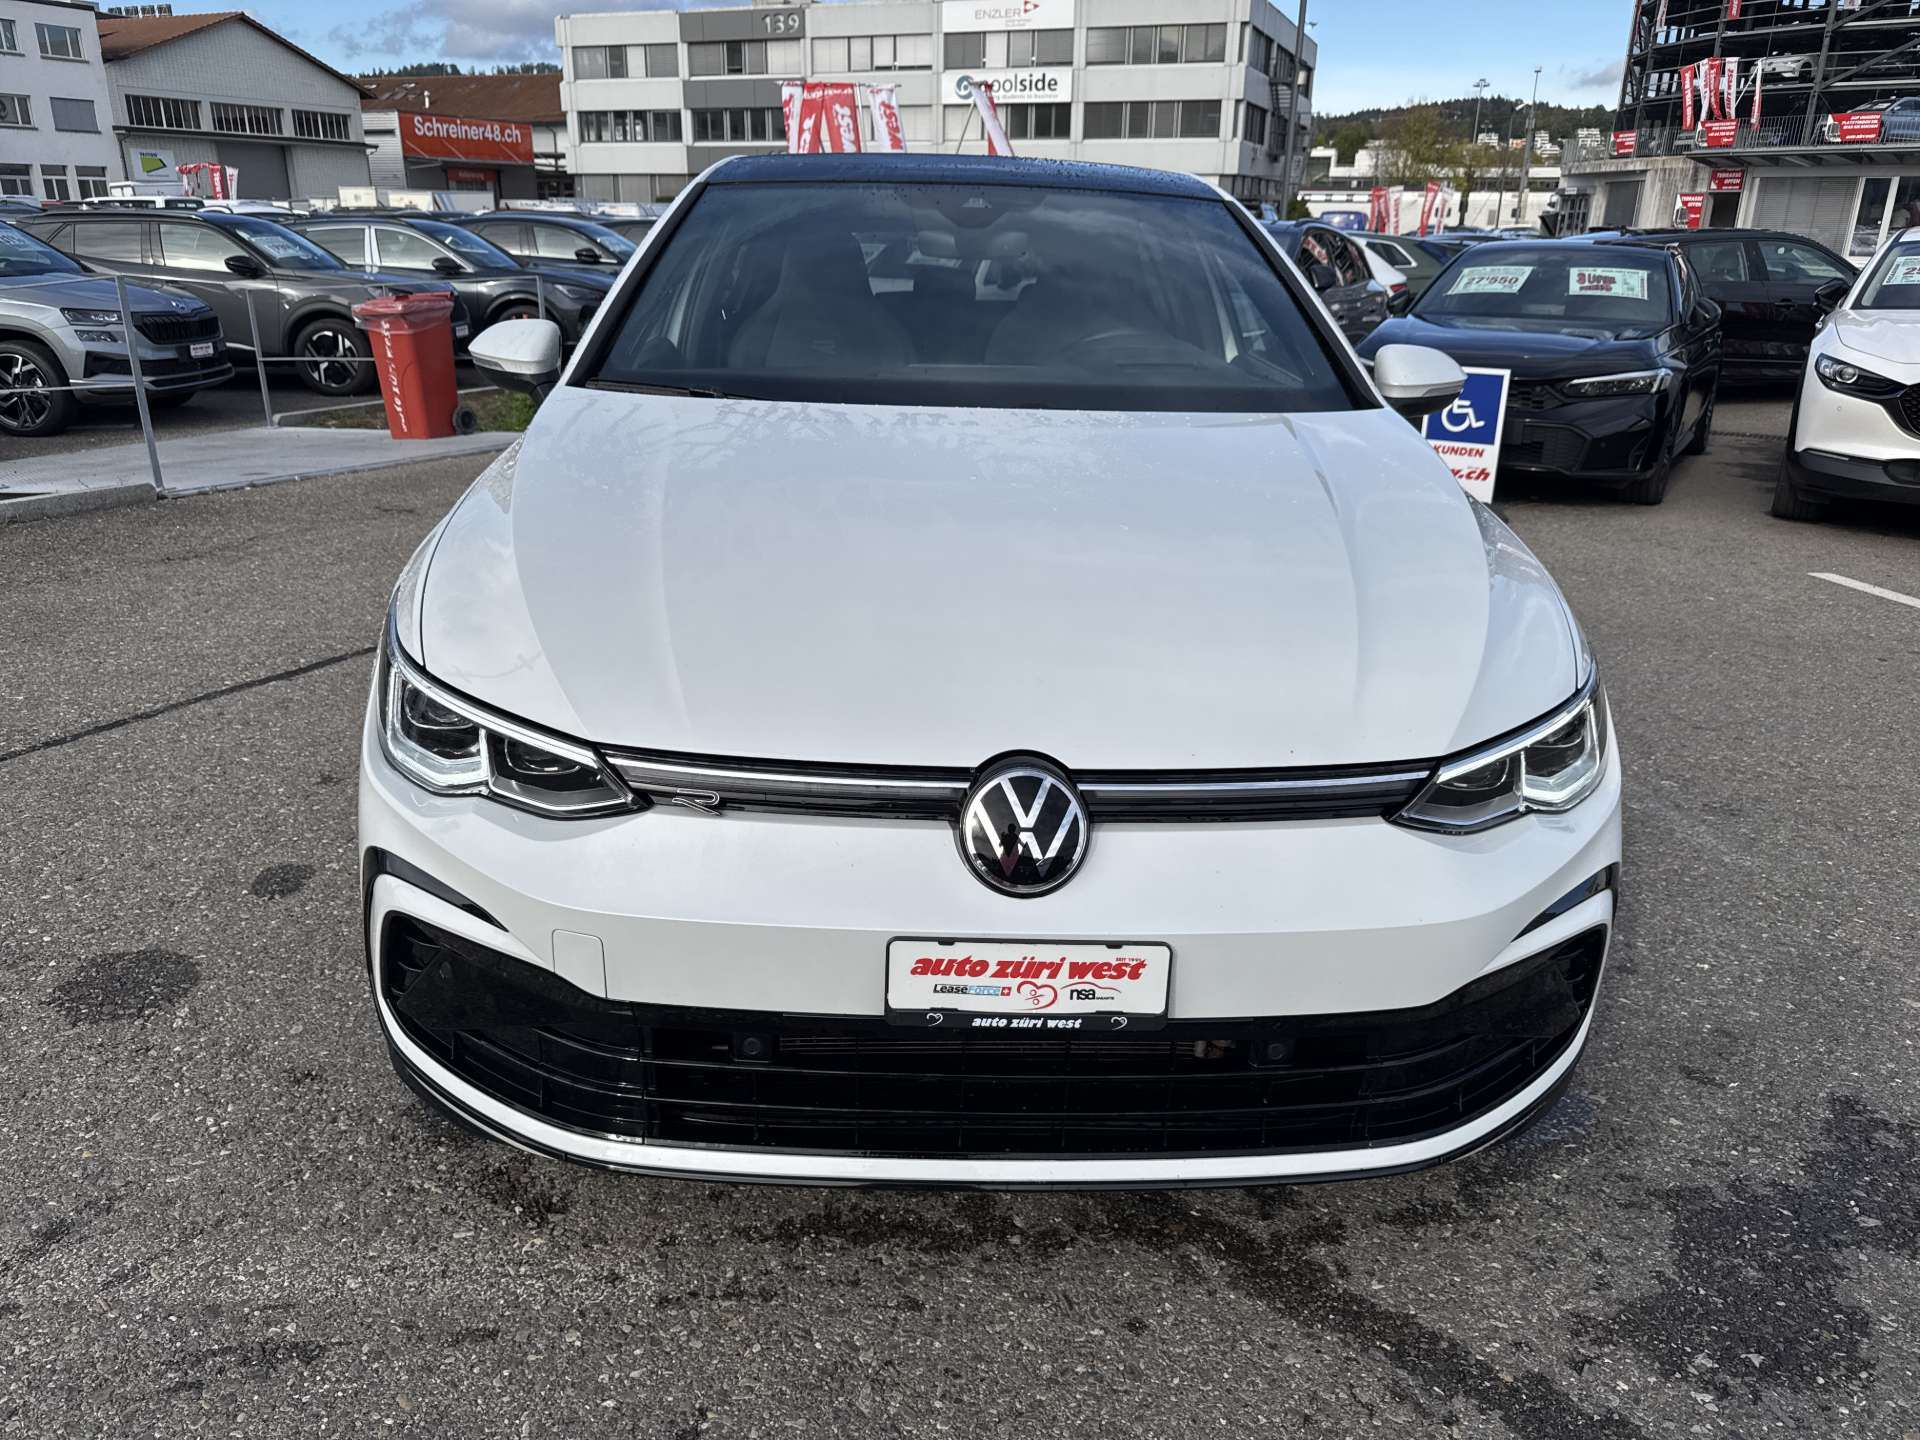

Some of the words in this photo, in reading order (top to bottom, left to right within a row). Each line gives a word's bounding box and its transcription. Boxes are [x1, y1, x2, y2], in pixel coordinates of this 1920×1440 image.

[974, 8, 1021, 20] ENZLER
[762, 14, 799, 33] 139
[984, 72, 1058, 93] oolside
[414, 116, 521, 143] Schreiner48.ch
[879, 101, 903, 150] west
[1433, 444, 1485, 458] KUNDEN
[910, 955, 990, 978] auto
[989, 956, 1067, 980] züri
[1067, 959, 1148, 980] west
[933, 984, 1001, 996] LeaseForce
[1069, 988, 1096, 1001] nsa
[972, 1017, 1008, 1027] auto
[1009, 1017, 1043, 1028] züri
[1046, 1018, 1082, 1029] west
